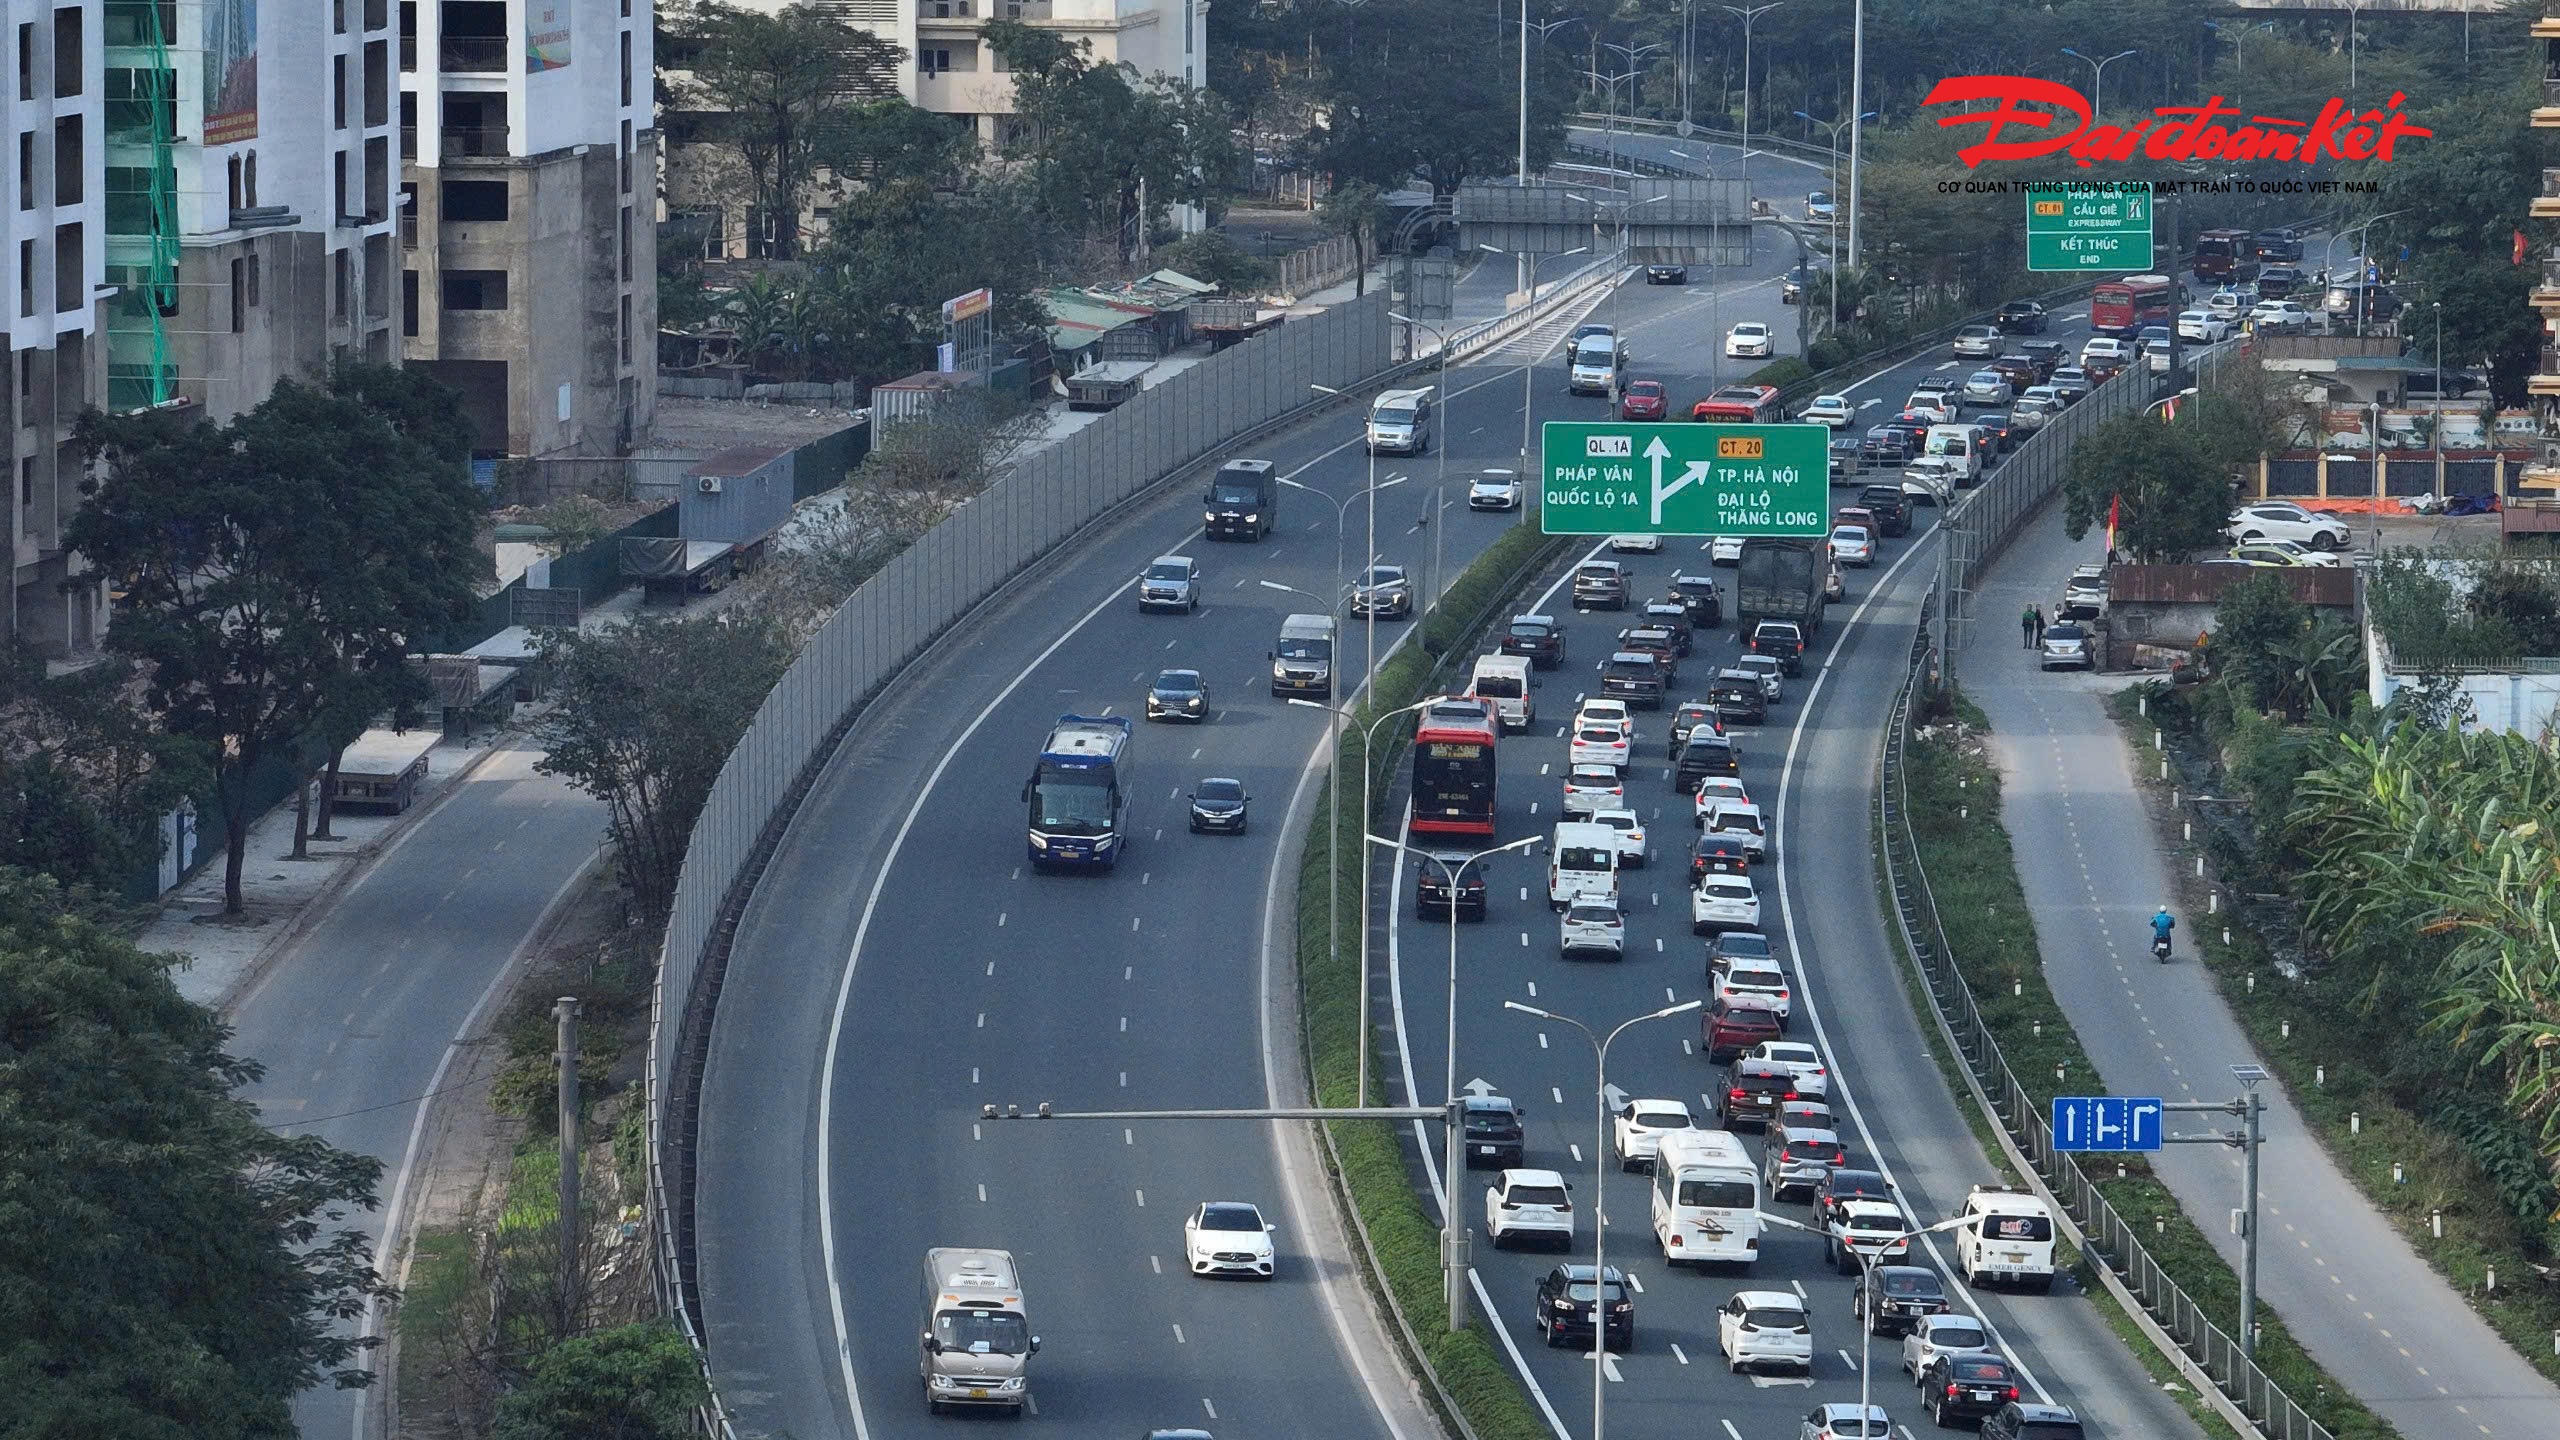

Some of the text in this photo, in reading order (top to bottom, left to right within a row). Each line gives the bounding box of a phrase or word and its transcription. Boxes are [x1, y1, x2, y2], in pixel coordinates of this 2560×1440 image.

[2067, 219, 2122, 227] EXPRESSWAY
[2060, 235, 2119, 250] KẾT THÚC
[2079, 255, 2101, 264] END
[1555, 464, 1632, 482] PHÁP VÂN
[1772, 466, 1799, 486] NỘI
[1547, 486, 1639, 508] QUỐC LỘ 1A
[1717, 490, 1771, 510] ĐẠI LỘ
[1717, 508, 1818, 525] THĂNG LONG
